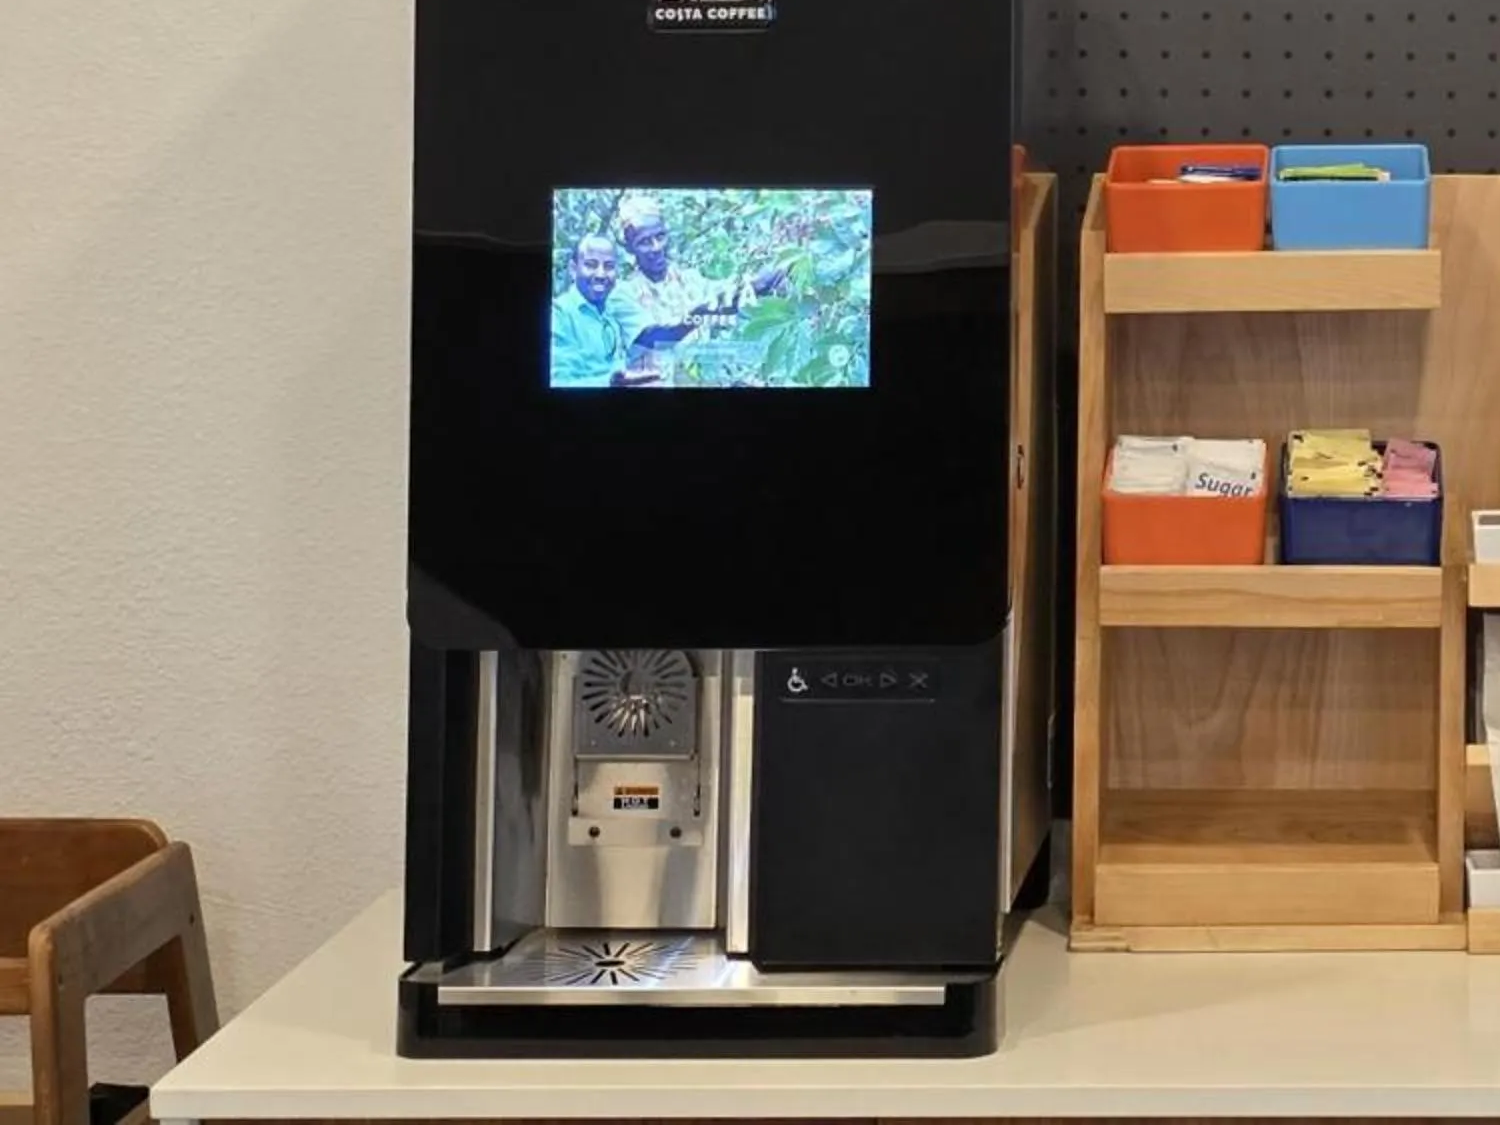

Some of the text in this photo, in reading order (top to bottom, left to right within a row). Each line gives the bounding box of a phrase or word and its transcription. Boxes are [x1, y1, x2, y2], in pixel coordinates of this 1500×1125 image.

[655, 7, 767, 22] COSTA COFFEE
[1194, 472, 1254, 497] Sugar
